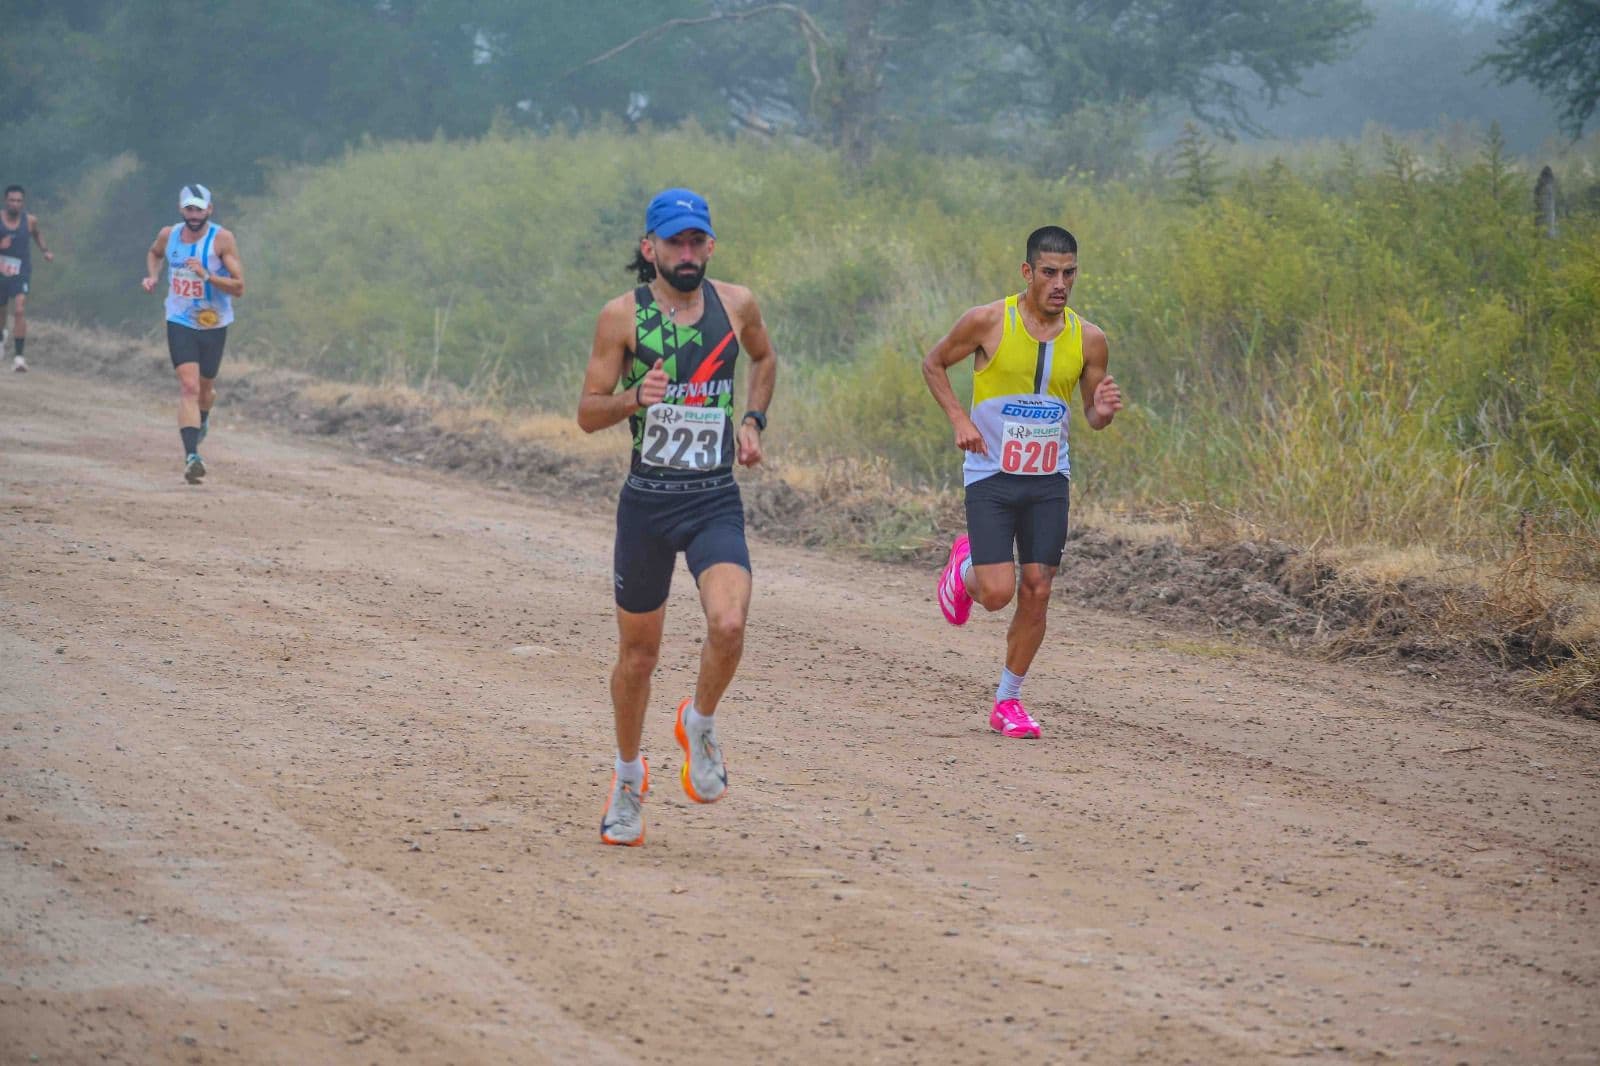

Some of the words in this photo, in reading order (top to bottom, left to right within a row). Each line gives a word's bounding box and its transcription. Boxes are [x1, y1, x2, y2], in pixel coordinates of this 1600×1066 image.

[173, 277, 203, 297] 625
[664, 379, 732, 398] RENALIN
[684, 410, 722, 421] RUFF
[1001, 403, 1060, 419] EDUBUS
[1033, 427, 1060, 435] RUFF
[643, 424, 718, 469] 223
[1002, 440, 1058, 473] 620
